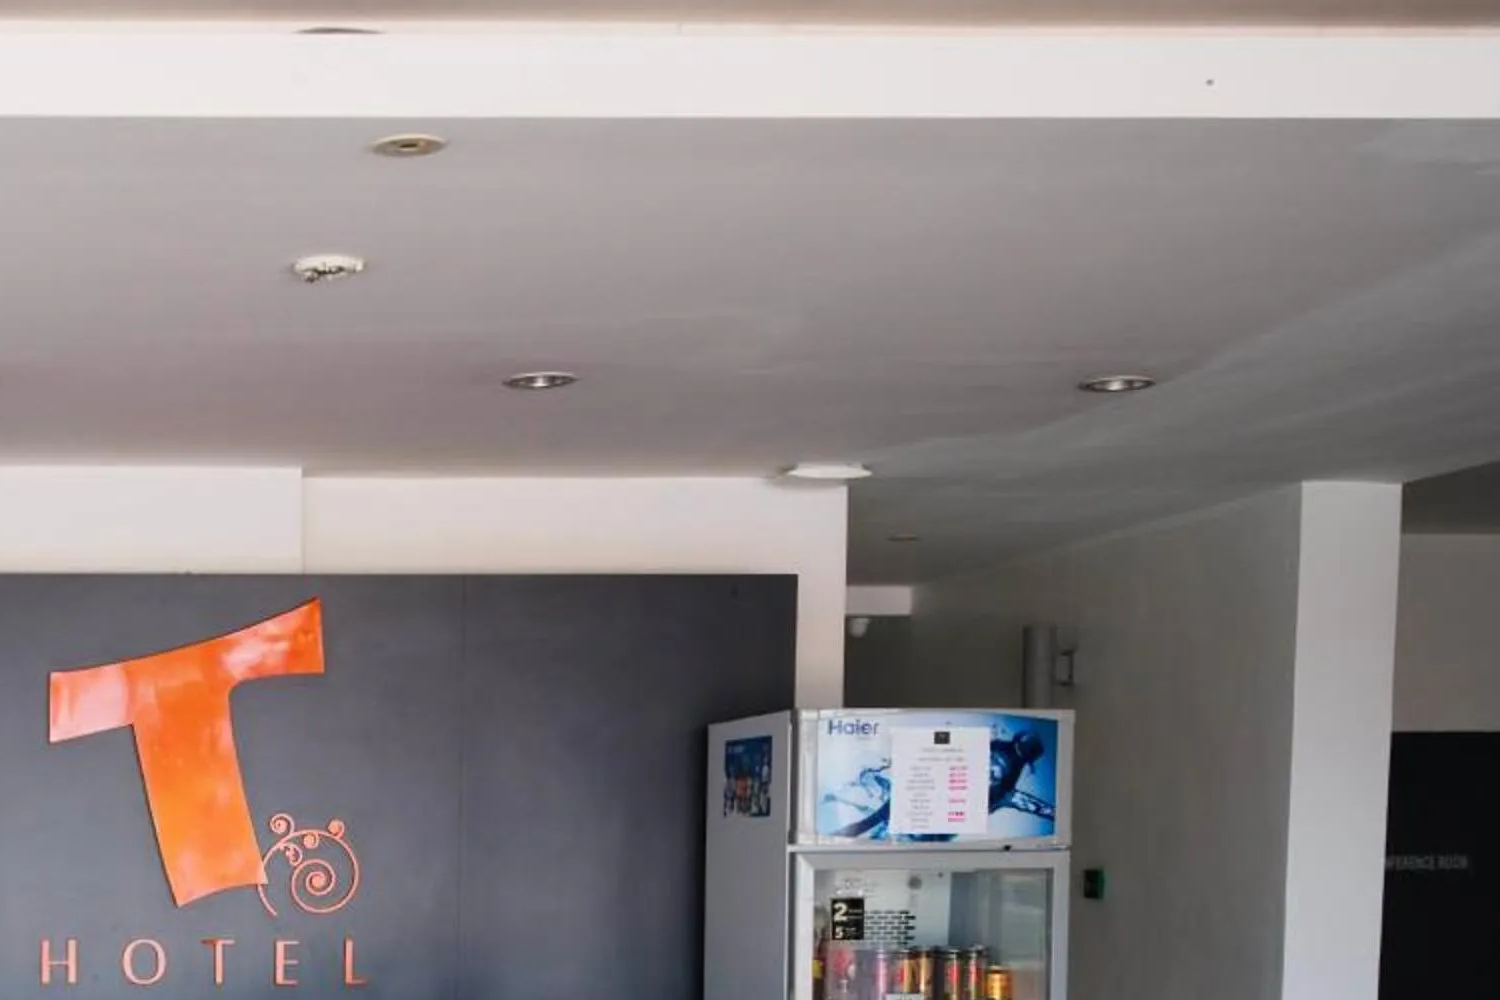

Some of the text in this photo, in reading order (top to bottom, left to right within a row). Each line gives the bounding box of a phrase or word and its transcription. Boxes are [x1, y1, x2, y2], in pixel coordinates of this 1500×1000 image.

[828, 719, 880, 736] Haier
[48, 596, 326, 909] T
[833, 902, 848, 922] 2
[39, 938, 370, 985] HOTEL
